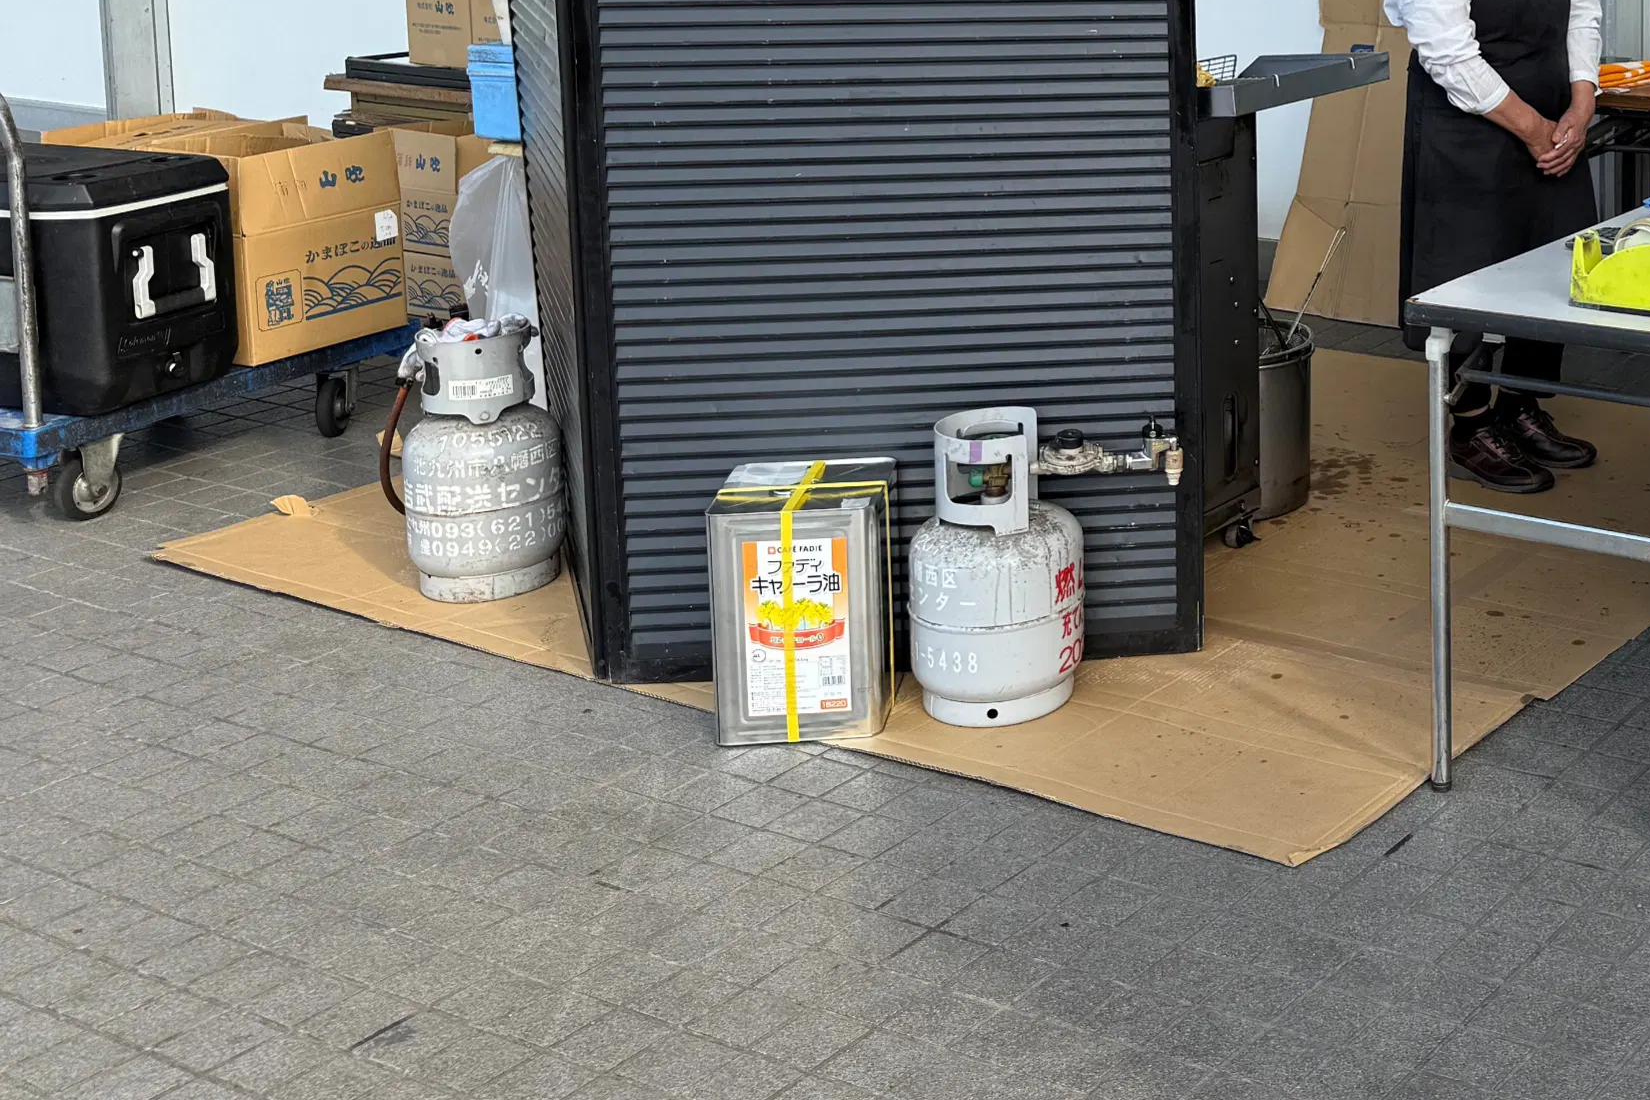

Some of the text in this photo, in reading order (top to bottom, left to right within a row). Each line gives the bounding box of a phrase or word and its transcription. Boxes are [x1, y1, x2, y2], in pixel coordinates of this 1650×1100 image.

[319, 166, 365, 189] 山吹
[799, 544, 822, 552] FADIE
[752, 573, 841, 595] キャノーラ油
